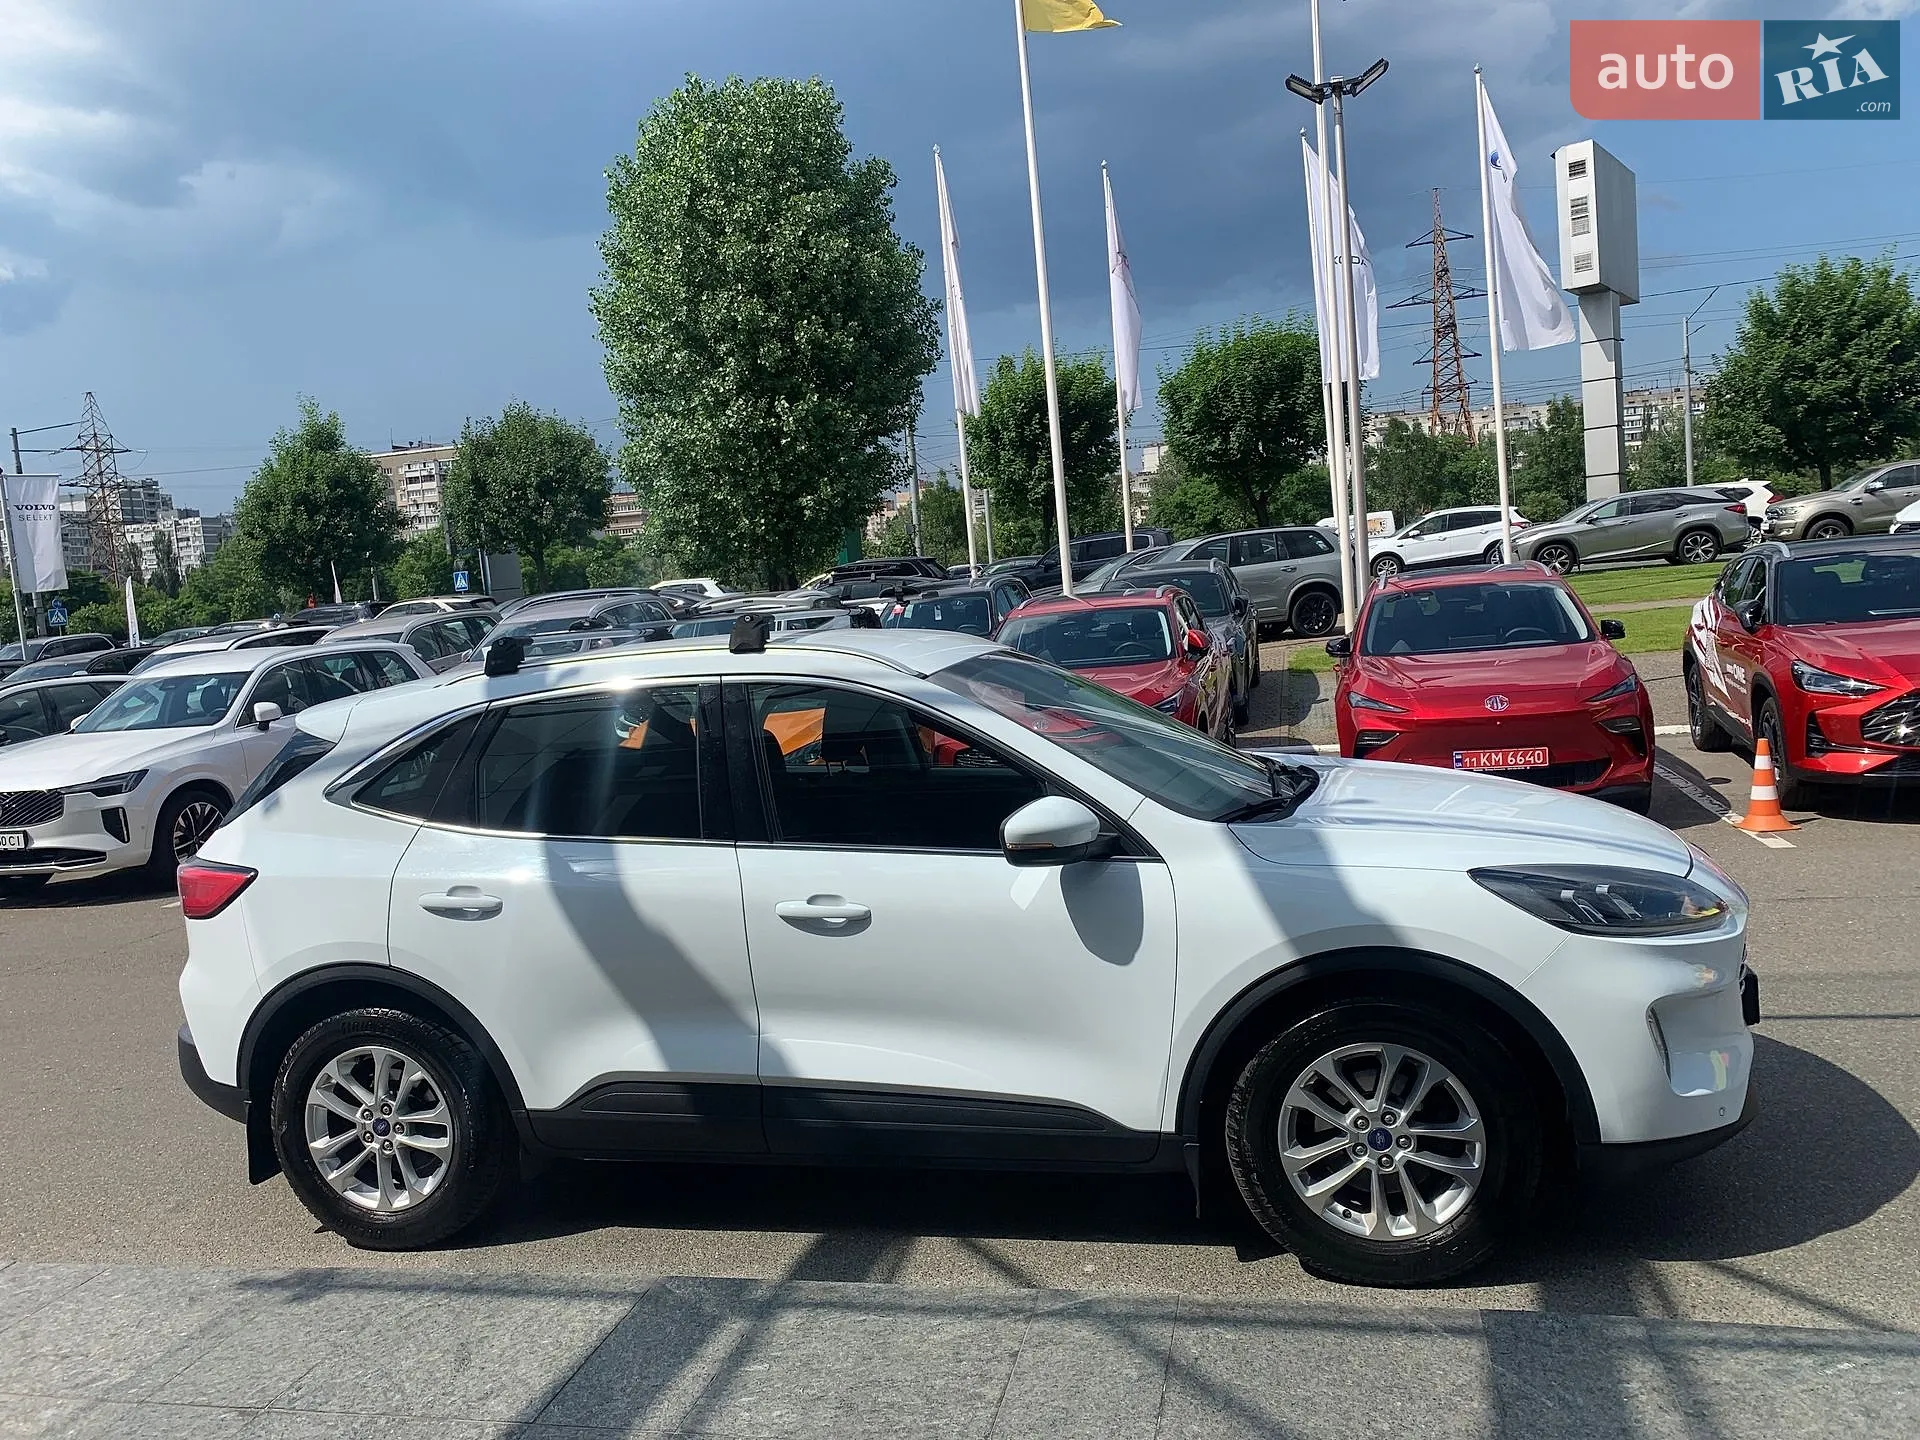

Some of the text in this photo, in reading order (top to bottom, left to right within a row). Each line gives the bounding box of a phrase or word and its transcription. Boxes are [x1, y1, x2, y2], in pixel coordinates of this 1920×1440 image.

[1486, 695, 1508, 711] MG
[1464, 750, 1544, 767] 11 KM 6640
